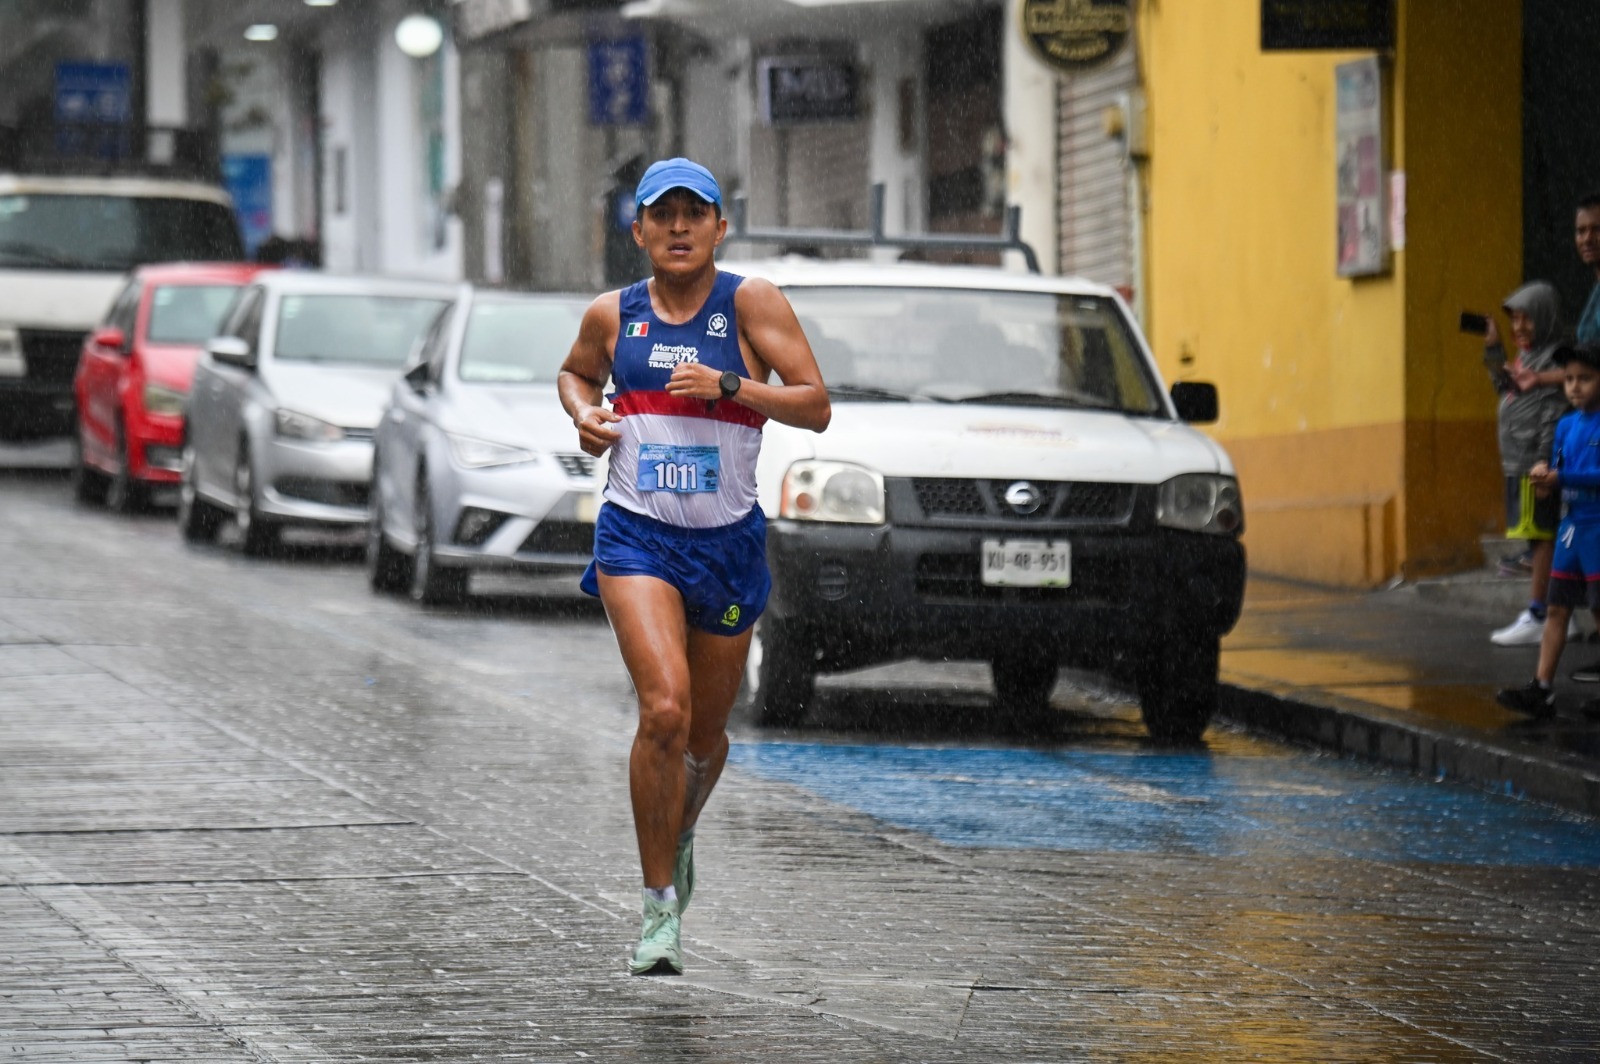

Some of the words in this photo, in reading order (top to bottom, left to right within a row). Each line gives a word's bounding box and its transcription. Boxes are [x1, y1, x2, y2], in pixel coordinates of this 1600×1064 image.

[652, 343, 698, 353] Marathon
[648, 361, 675, 369] TRACK
[654, 462, 698, 490] 1011
